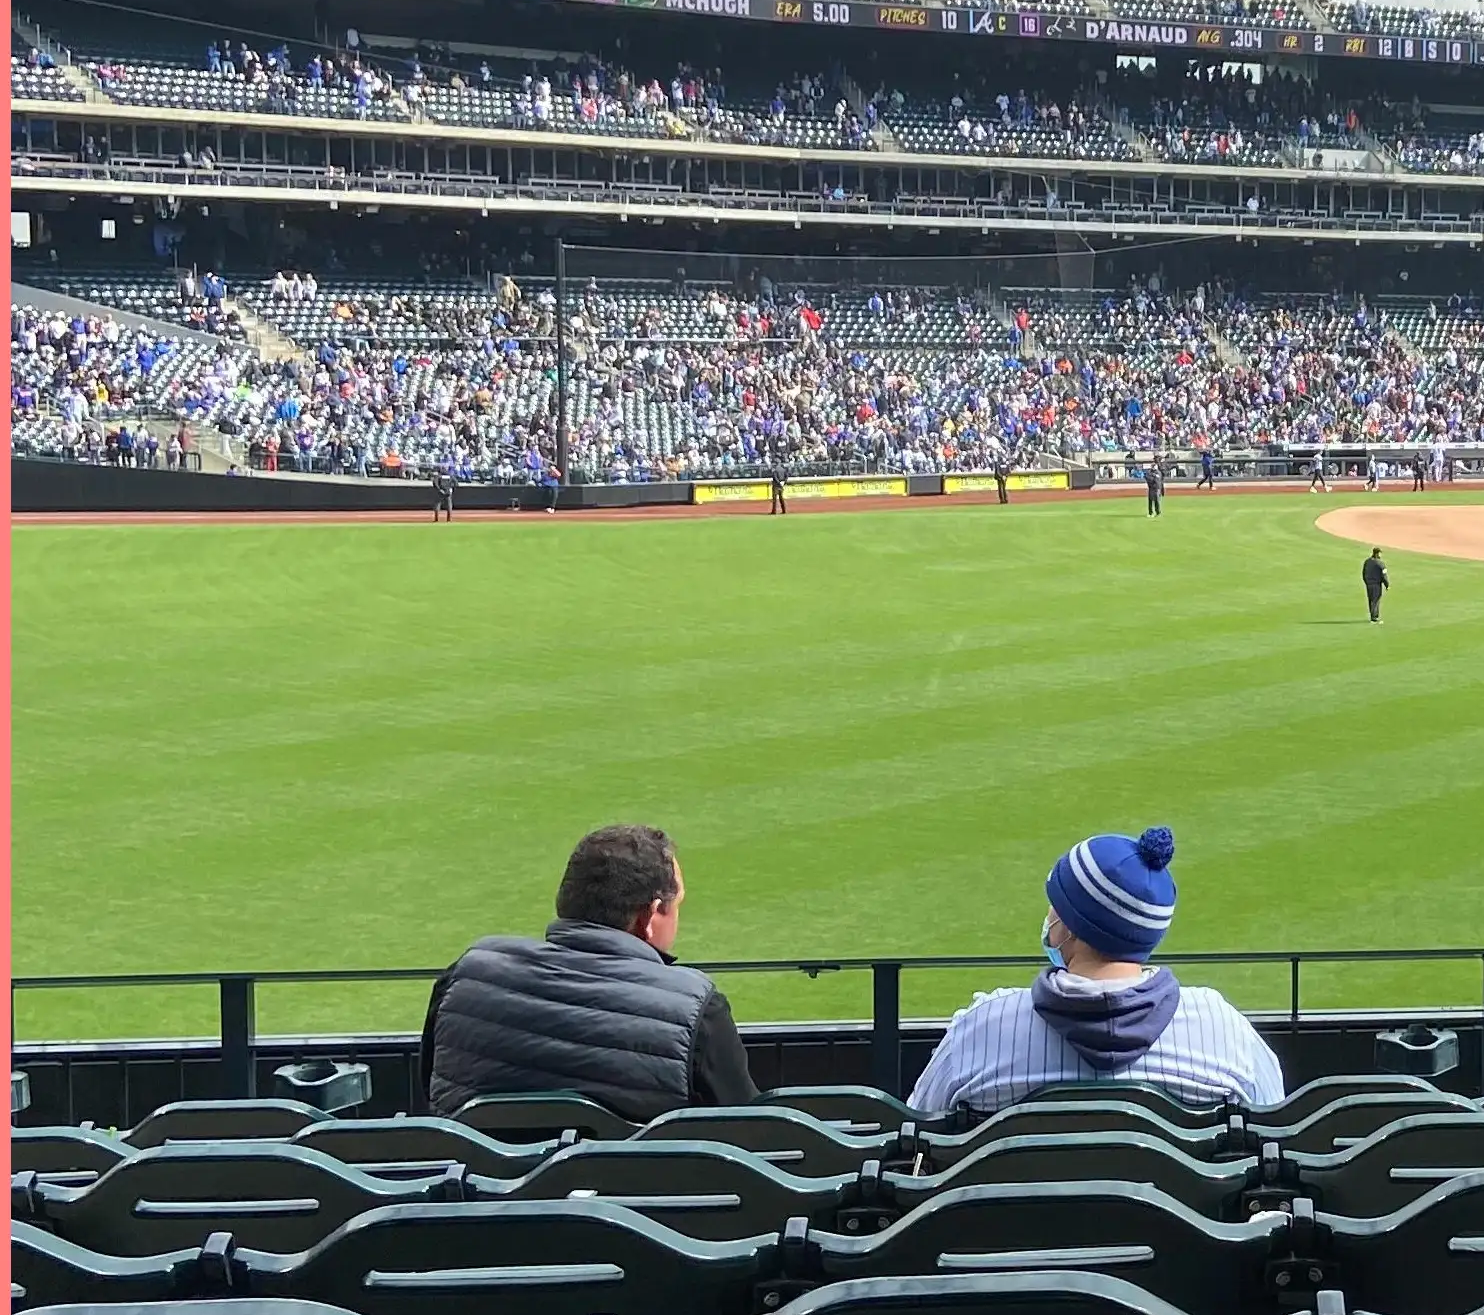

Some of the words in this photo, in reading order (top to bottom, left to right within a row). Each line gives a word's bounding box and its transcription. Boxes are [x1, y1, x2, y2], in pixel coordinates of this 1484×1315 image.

[776, 1, 801, 17] ERA
[813, 2, 850, 25] 5.00
[879, 8, 926, 26] PITCHES
[941, 11, 957, 29] 10
[998, 15, 1006, 31] C
[1085, 21, 1188, 44] D'ARNAUD
[1230, 29, 1262, 48] .304
[1283, 35, 1298, 49] HR
[1314, 35, 1324, 52] 2
[1345, 37, 1366, 53] RBI
[1378, 38, 1393, 56] 12
[1428, 42, 1438, 60] S
